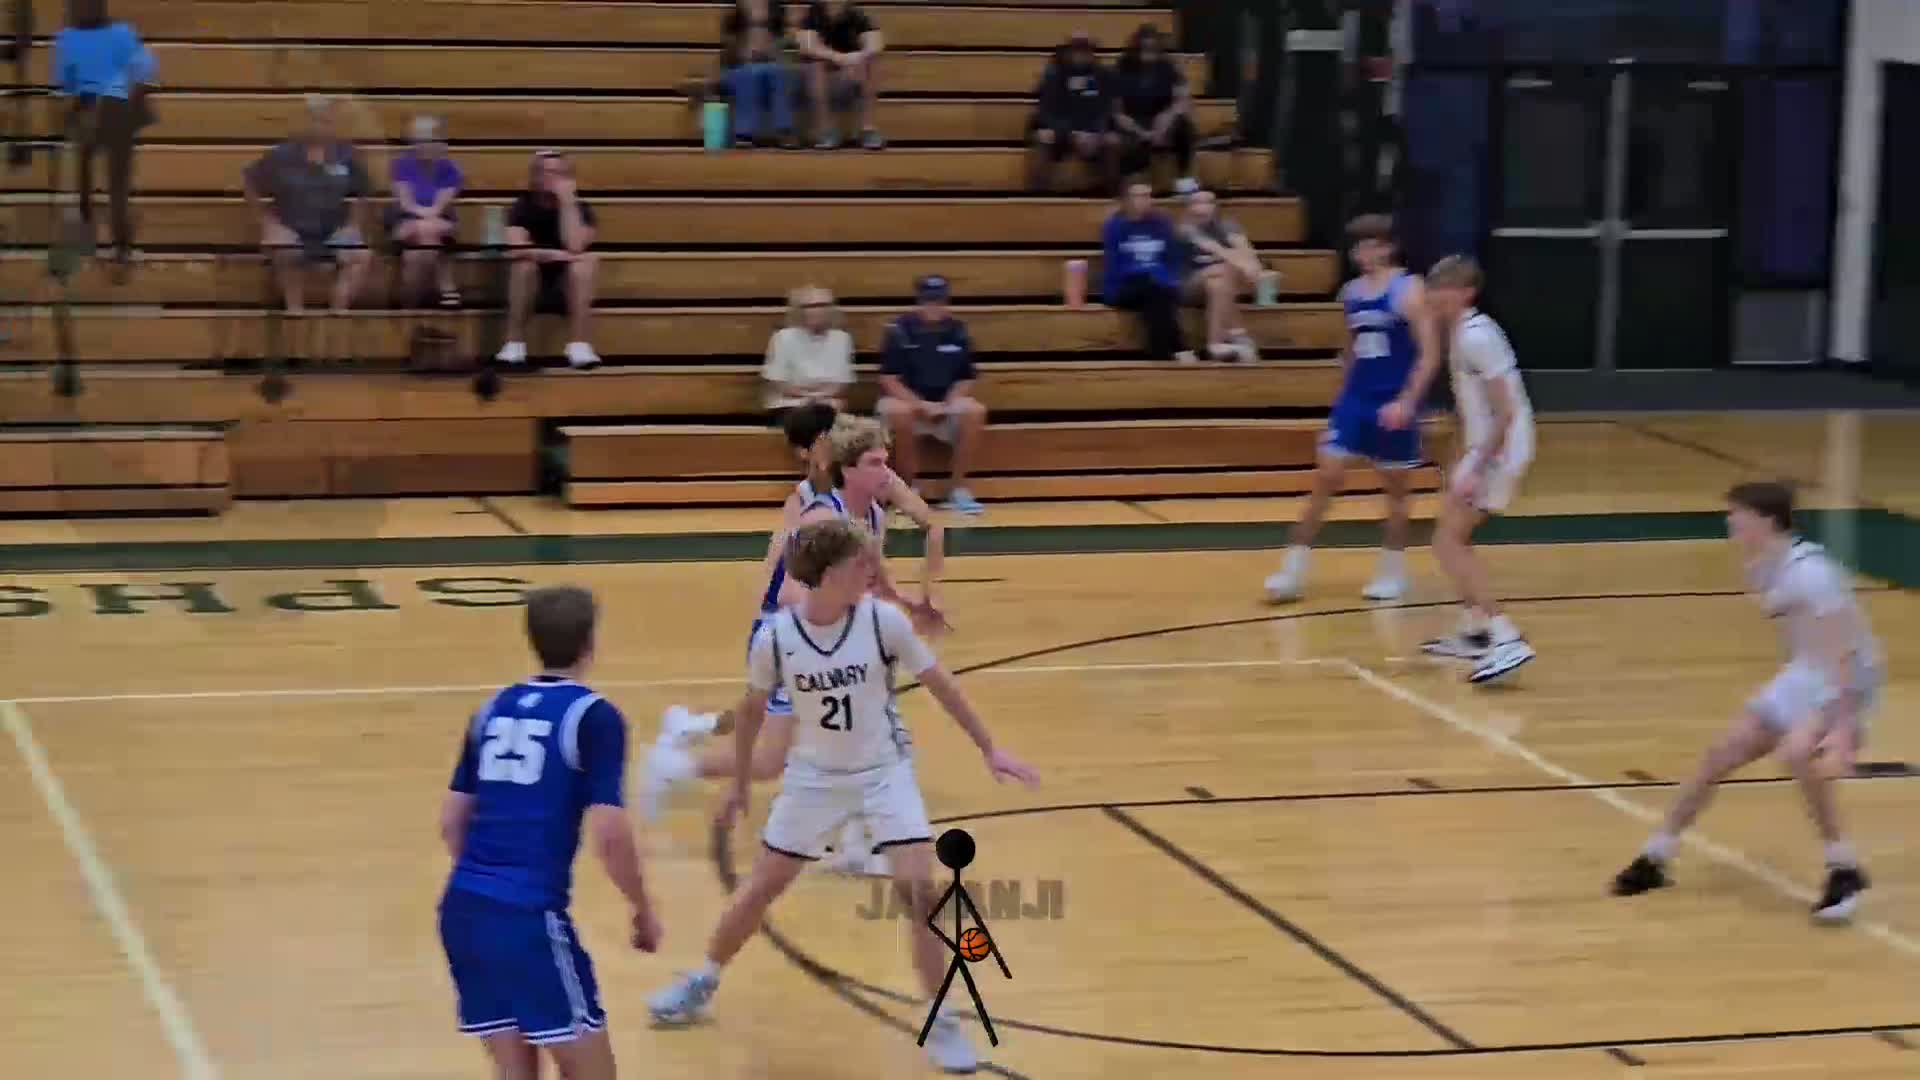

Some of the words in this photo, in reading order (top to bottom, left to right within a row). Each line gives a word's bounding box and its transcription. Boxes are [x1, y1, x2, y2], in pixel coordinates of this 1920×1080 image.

[794, 663, 868, 693] CALVARY
[820, 694, 853, 732] 21
[477, 716, 553, 786] 25
